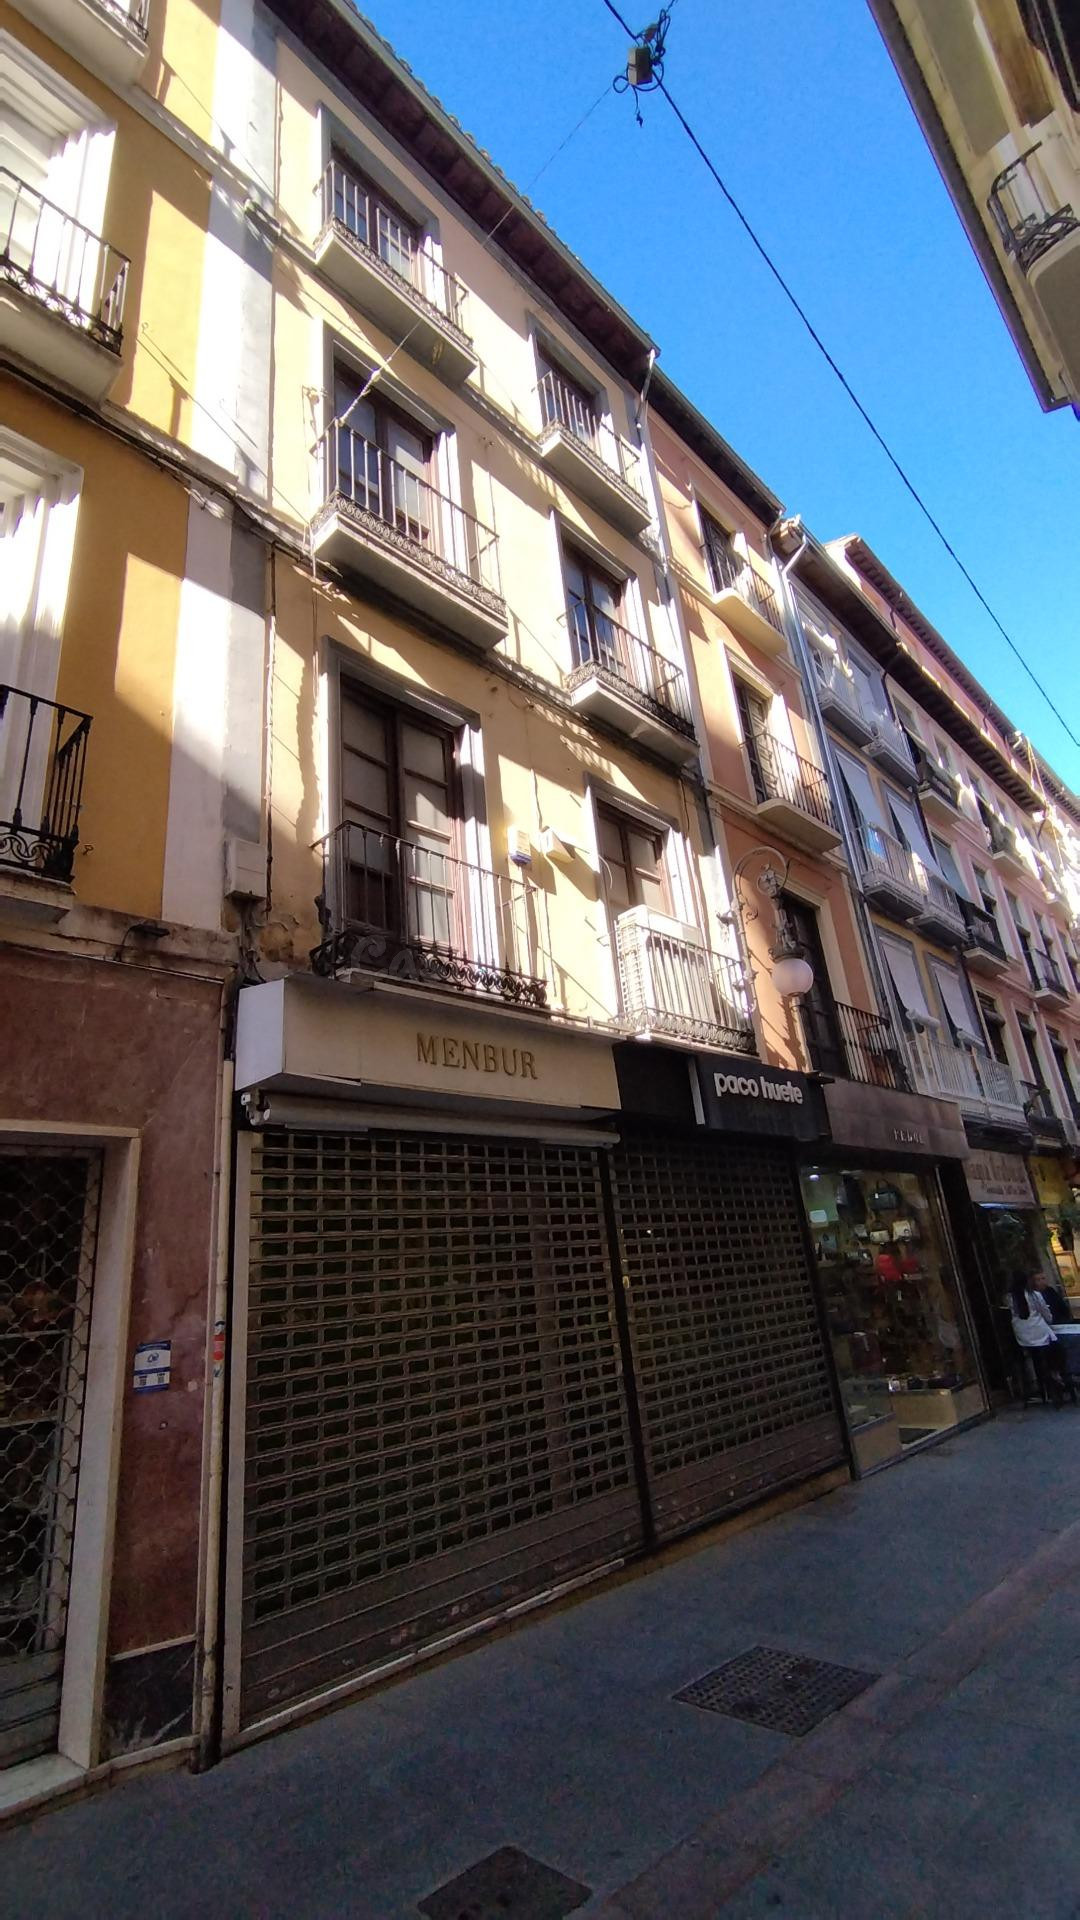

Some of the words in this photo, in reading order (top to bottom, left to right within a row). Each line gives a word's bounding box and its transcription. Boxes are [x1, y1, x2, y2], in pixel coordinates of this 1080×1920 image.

[416, 1032, 538, 1080] MENBUR
[713, 1072, 759, 1097] paco
[760, 1076, 803, 1104] huete
